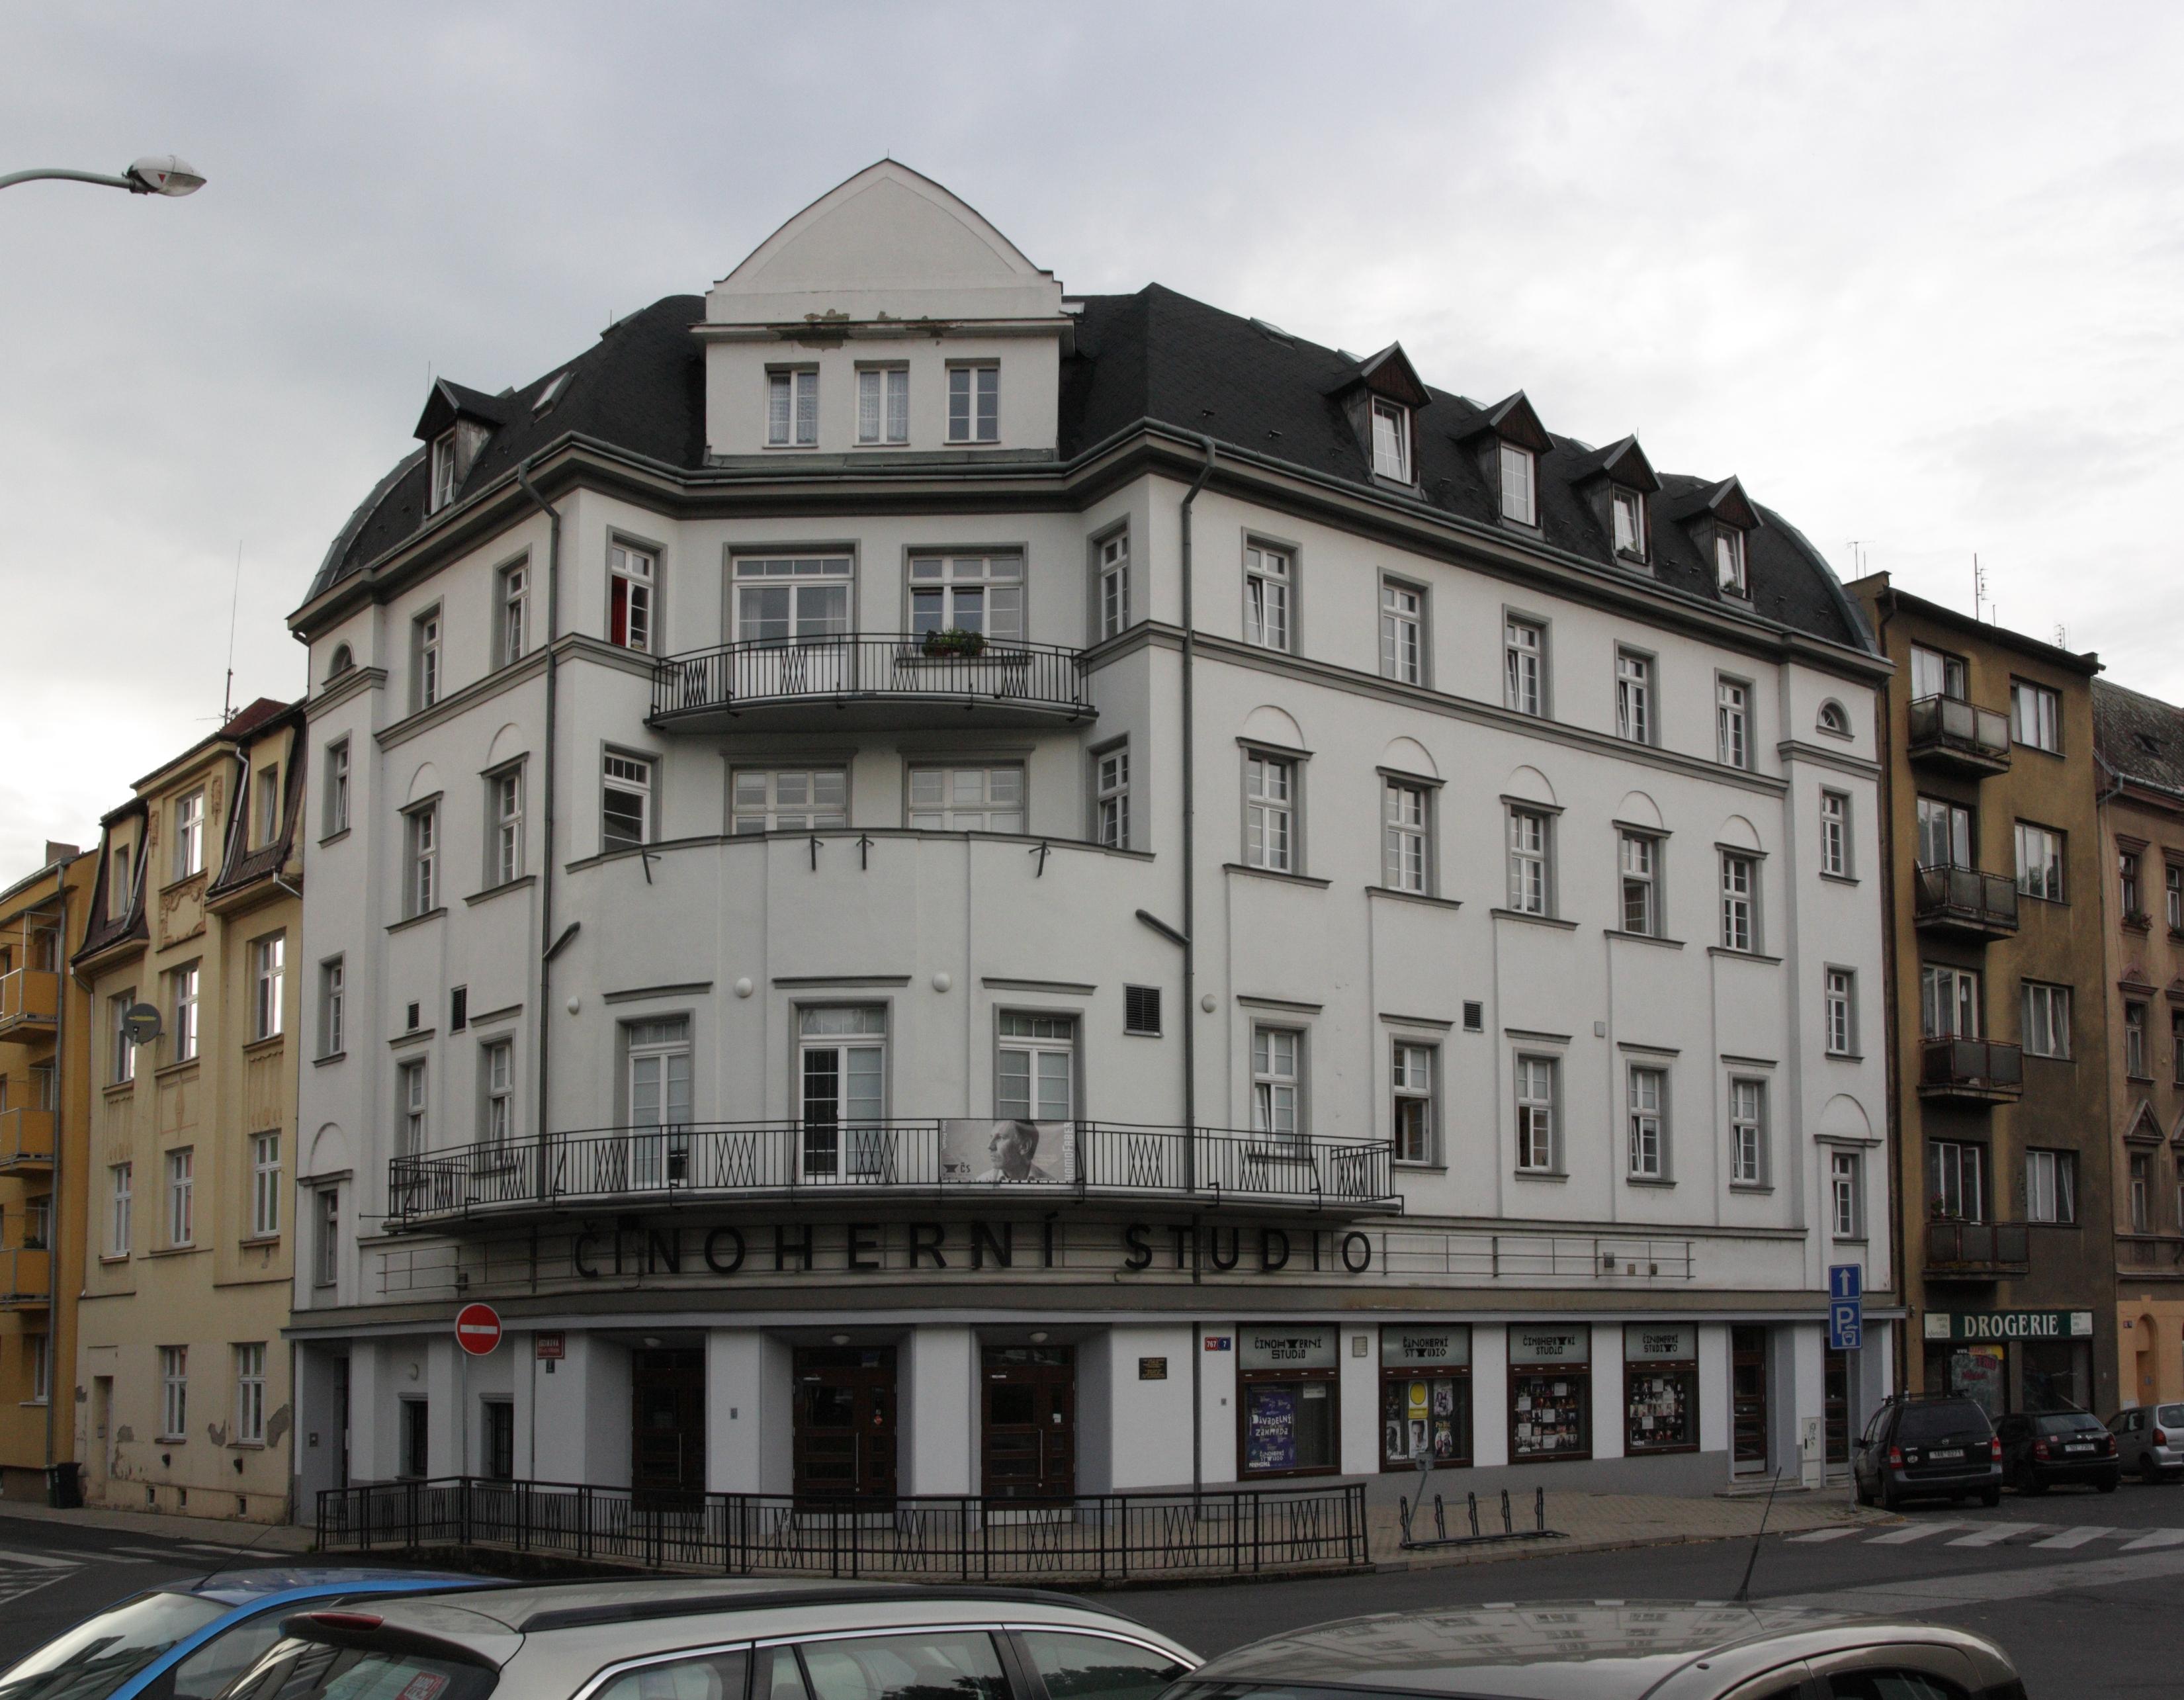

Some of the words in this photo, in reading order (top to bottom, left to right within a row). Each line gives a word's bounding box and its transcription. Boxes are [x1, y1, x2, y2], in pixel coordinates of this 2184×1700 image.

[574, 1212, 1059, 1278] ČINOHERNÍ
[1125, 1223, 1372, 1274] STUDIO
[1835, 1306, 1854, 1335] P
[1963, 1314, 2059, 1337] DROGERIE
